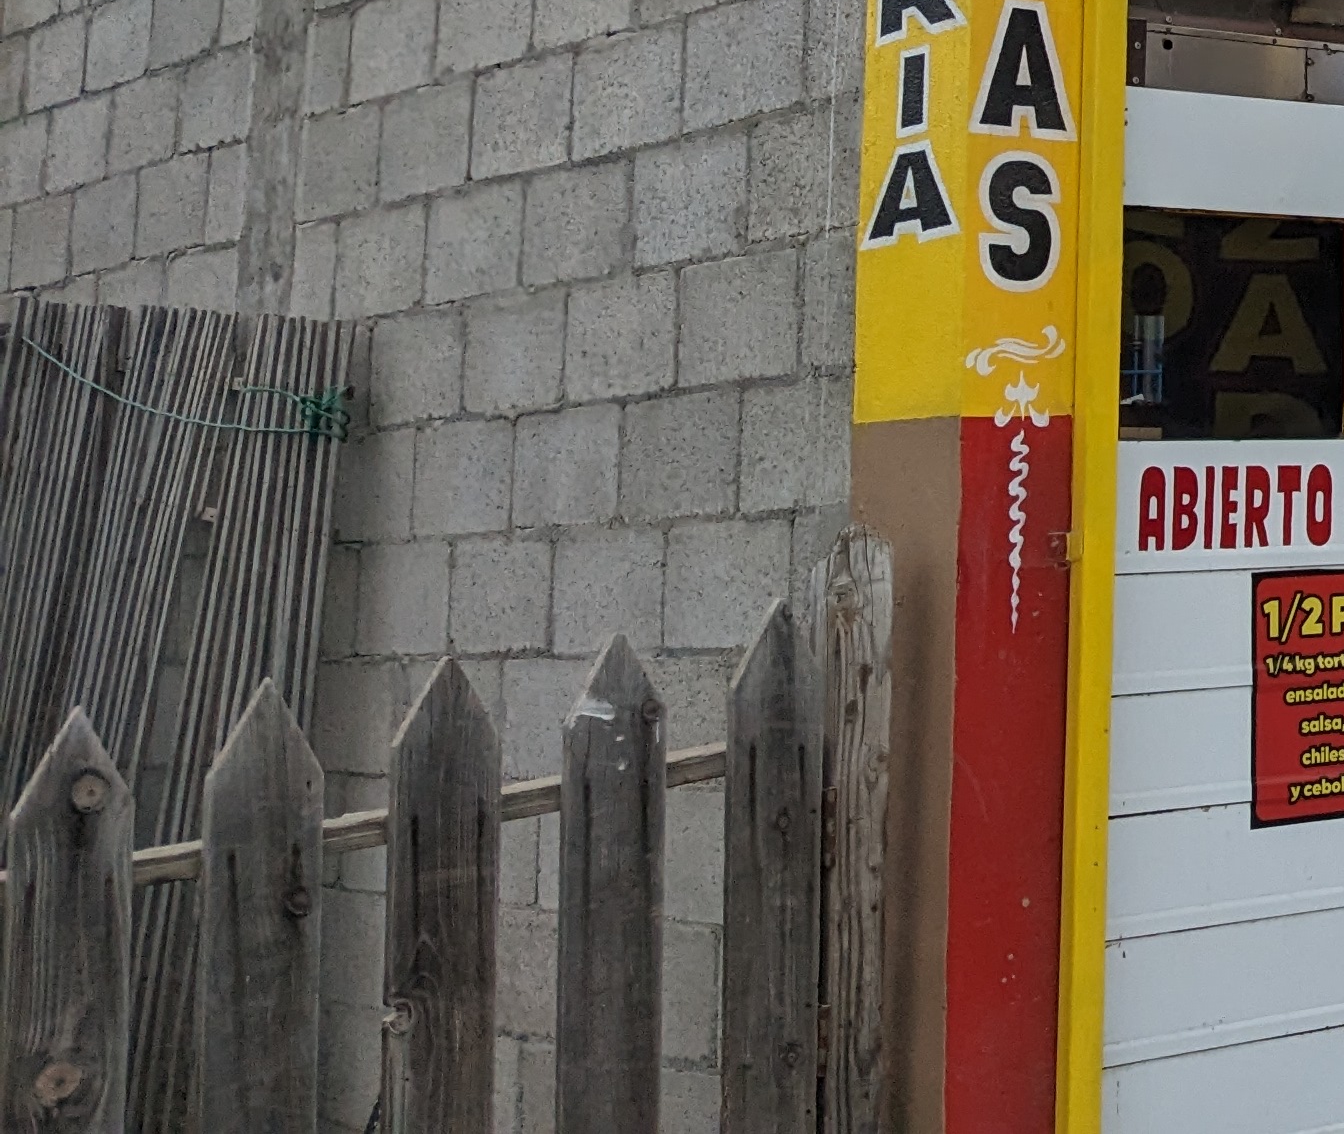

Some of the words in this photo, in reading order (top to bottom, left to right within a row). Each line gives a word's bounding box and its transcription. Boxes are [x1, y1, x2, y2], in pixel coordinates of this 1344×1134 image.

[1138, 464, 1332, 551] ABIERTO
[1263, 593, 1323, 642] 1/2
[1266, 654, 1292, 675] 1/4
[1296, 656, 1314, 674] kg
[1290, 783, 1302, 802] y
